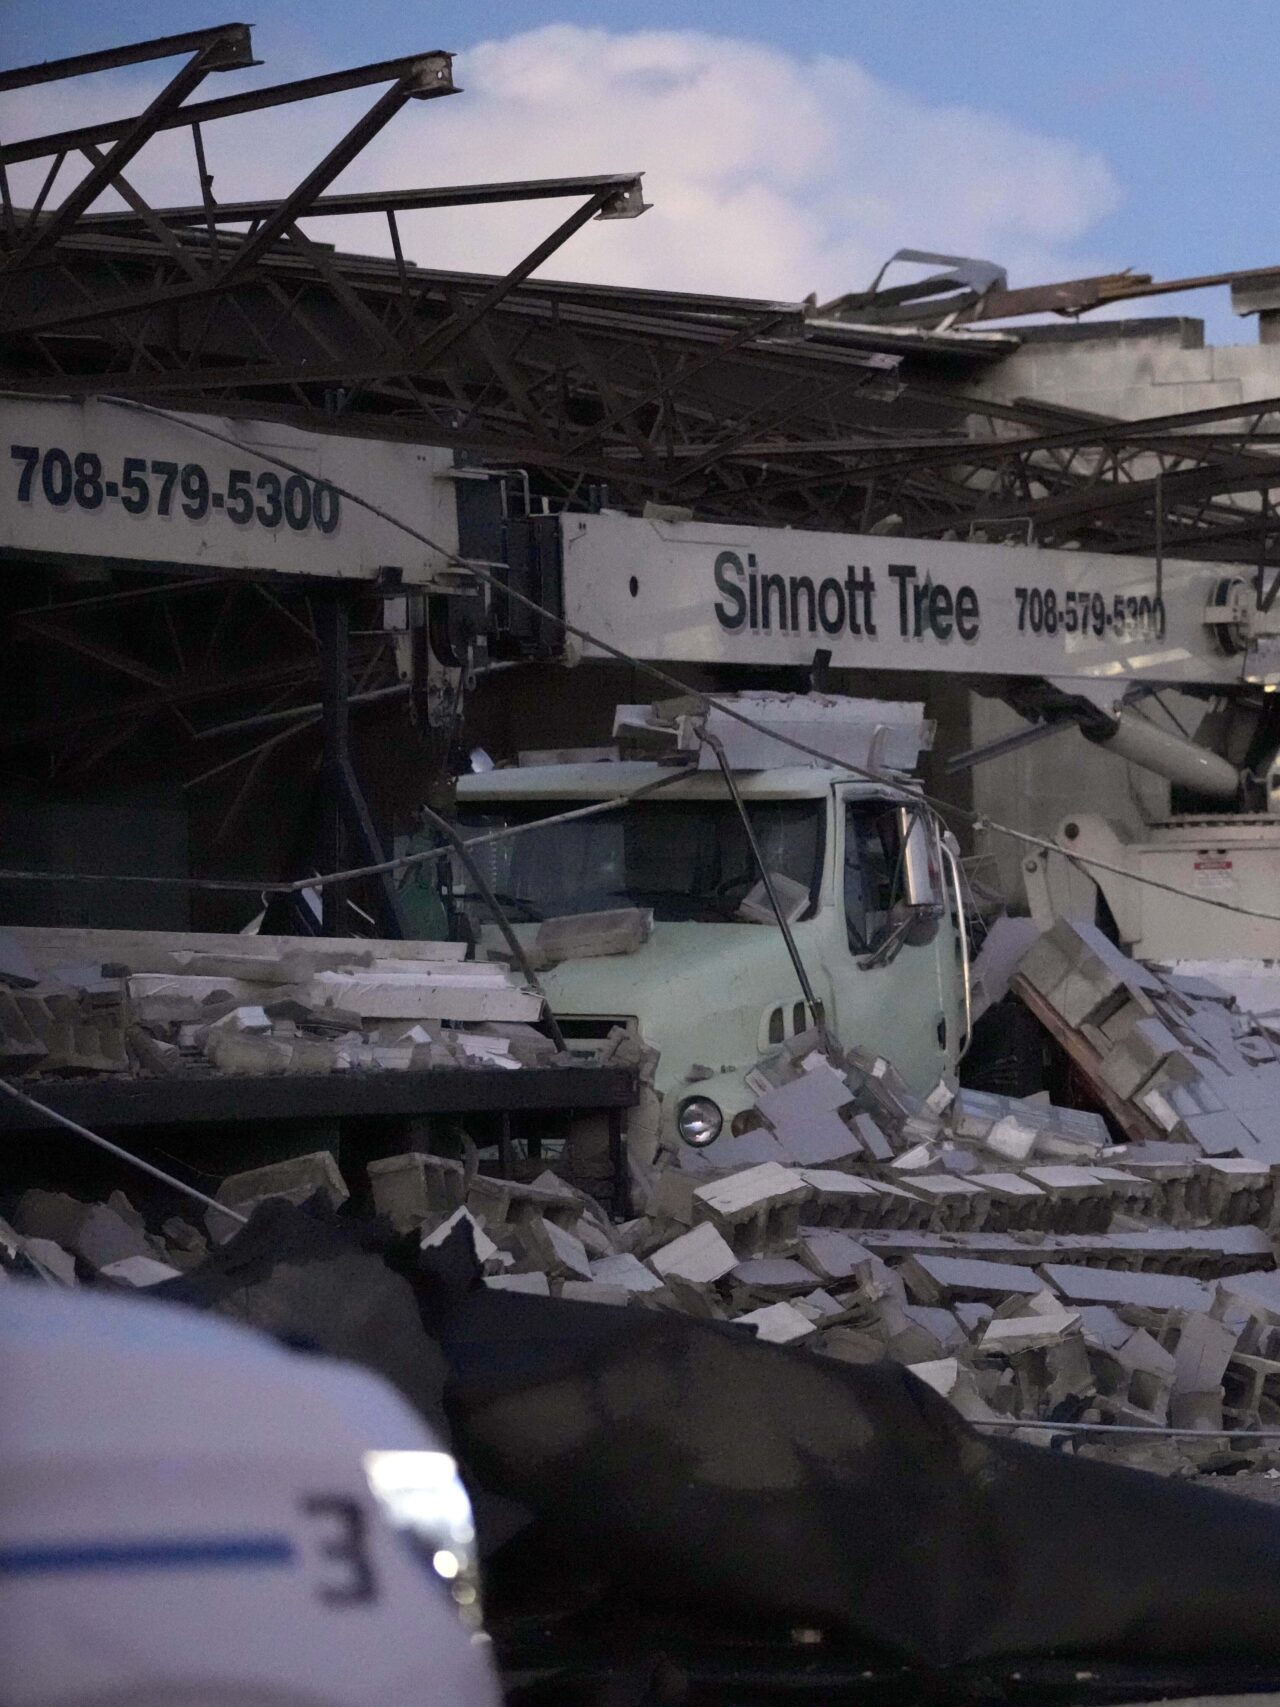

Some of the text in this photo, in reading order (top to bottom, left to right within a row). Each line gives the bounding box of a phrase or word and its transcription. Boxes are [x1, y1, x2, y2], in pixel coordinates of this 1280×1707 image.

[9, 444, 342, 535] 708-579-5300
[713, 550, 877, 636] Sinnott
[888, 563, 981, 641] Tree
[303, 1492, 380, 1606] 3
